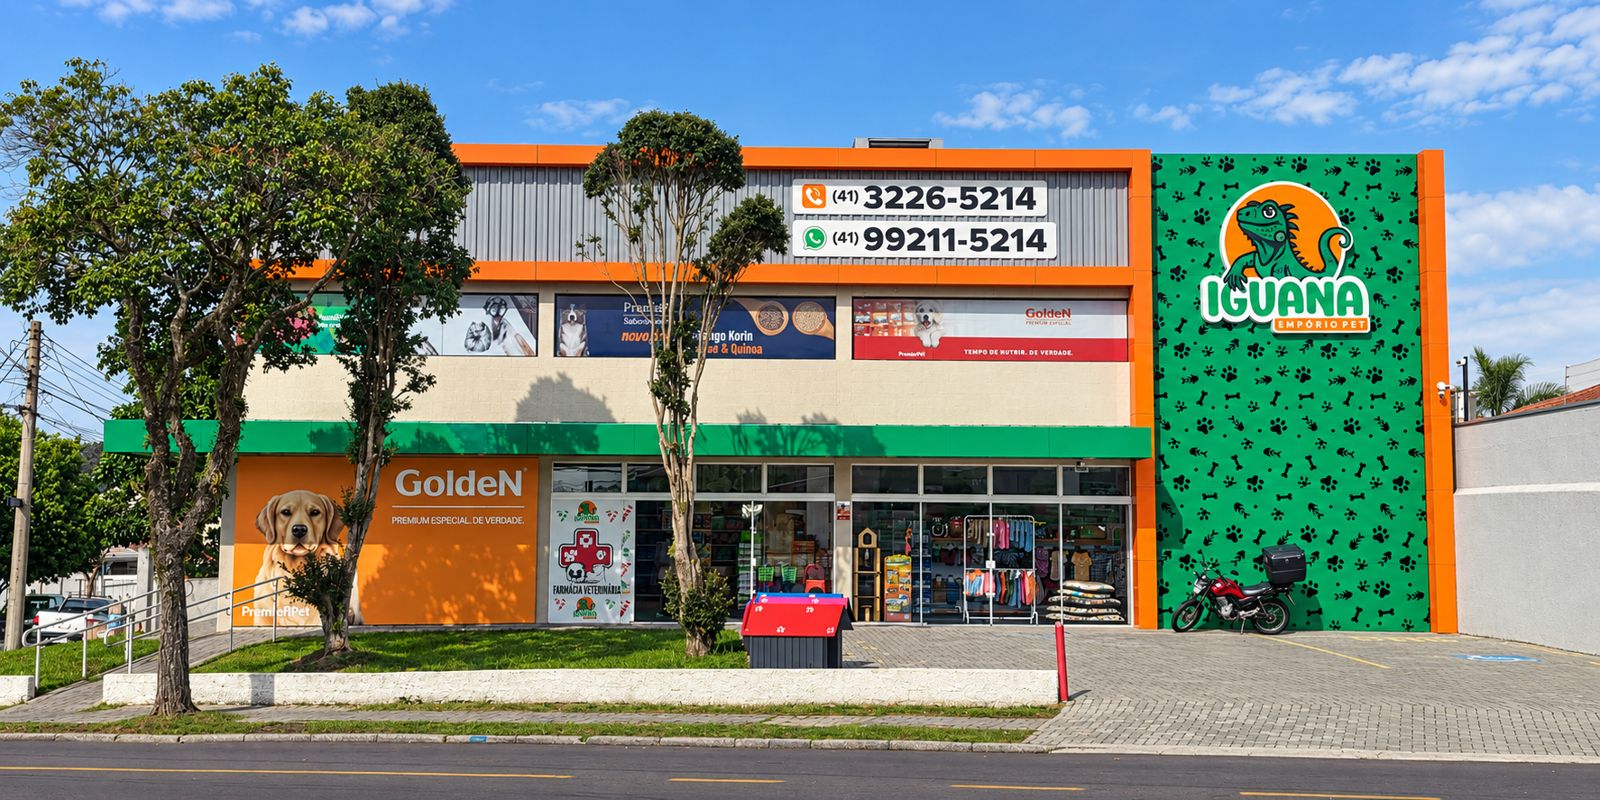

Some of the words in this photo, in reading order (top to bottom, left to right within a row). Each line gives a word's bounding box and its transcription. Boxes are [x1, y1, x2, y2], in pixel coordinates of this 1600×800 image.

[832, 190, 859, 205] (41)
[863, 185, 1037, 211] 3226-5214
[832, 231, 859, 246] (41)
[863, 226, 1048, 252] 99211-5214
[1205, 279, 1365, 318] IGUANA
[1025, 307, 1072, 319] GoldeN
[1278, 318, 1338, 329] EMPÓRIO
[1341, 320, 1366, 329] PET
[621, 331, 650, 342] novo
[728, 330, 753, 342] Korin
[721, 343, 729, 354] &
[731, 343, 763, 355] Quinoa
[395, 468, 523, 497] GoldeN
[391, 516, 430, 525] PREMIUM
[431, 516, 472, 525] ESPECIAL.
[473, 516, 484, 525] DE
[485, 516, 525, 525] VERDADE.
[552, 583, 582, 595] FARMÁCIA
[583, 583, 622, 595] VETERINÁRIA
